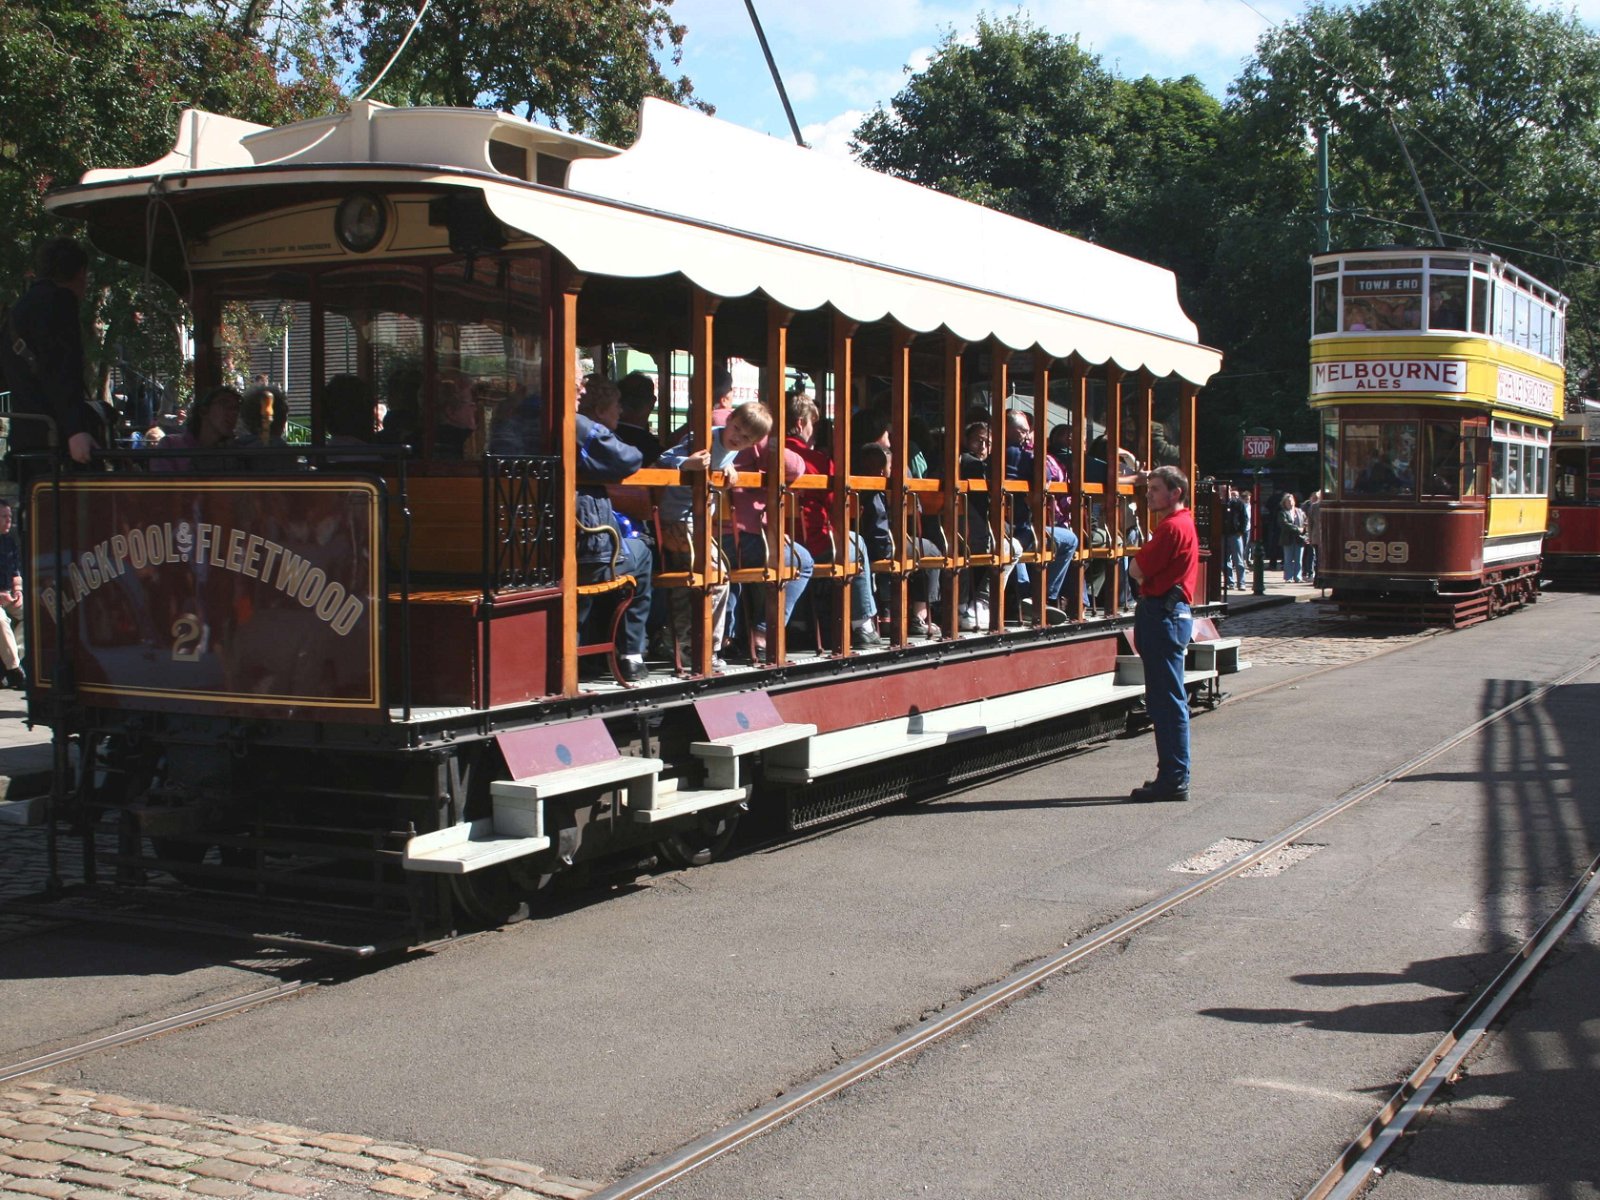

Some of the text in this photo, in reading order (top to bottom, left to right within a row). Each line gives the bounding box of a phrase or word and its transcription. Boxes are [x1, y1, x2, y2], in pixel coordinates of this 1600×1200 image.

[1359, 279, 1418, 290] TOWN END
[1316, 363, 1458, 386] MELBOURNE
[1356, 379, 1401, 389] ALES
[1247, 441, 1270, 455] STOP
[1344, 541, 1409, 564] 399
[197, 523, 363, 636] FLEETWOOD
[171, 613, 200, 662] 2
